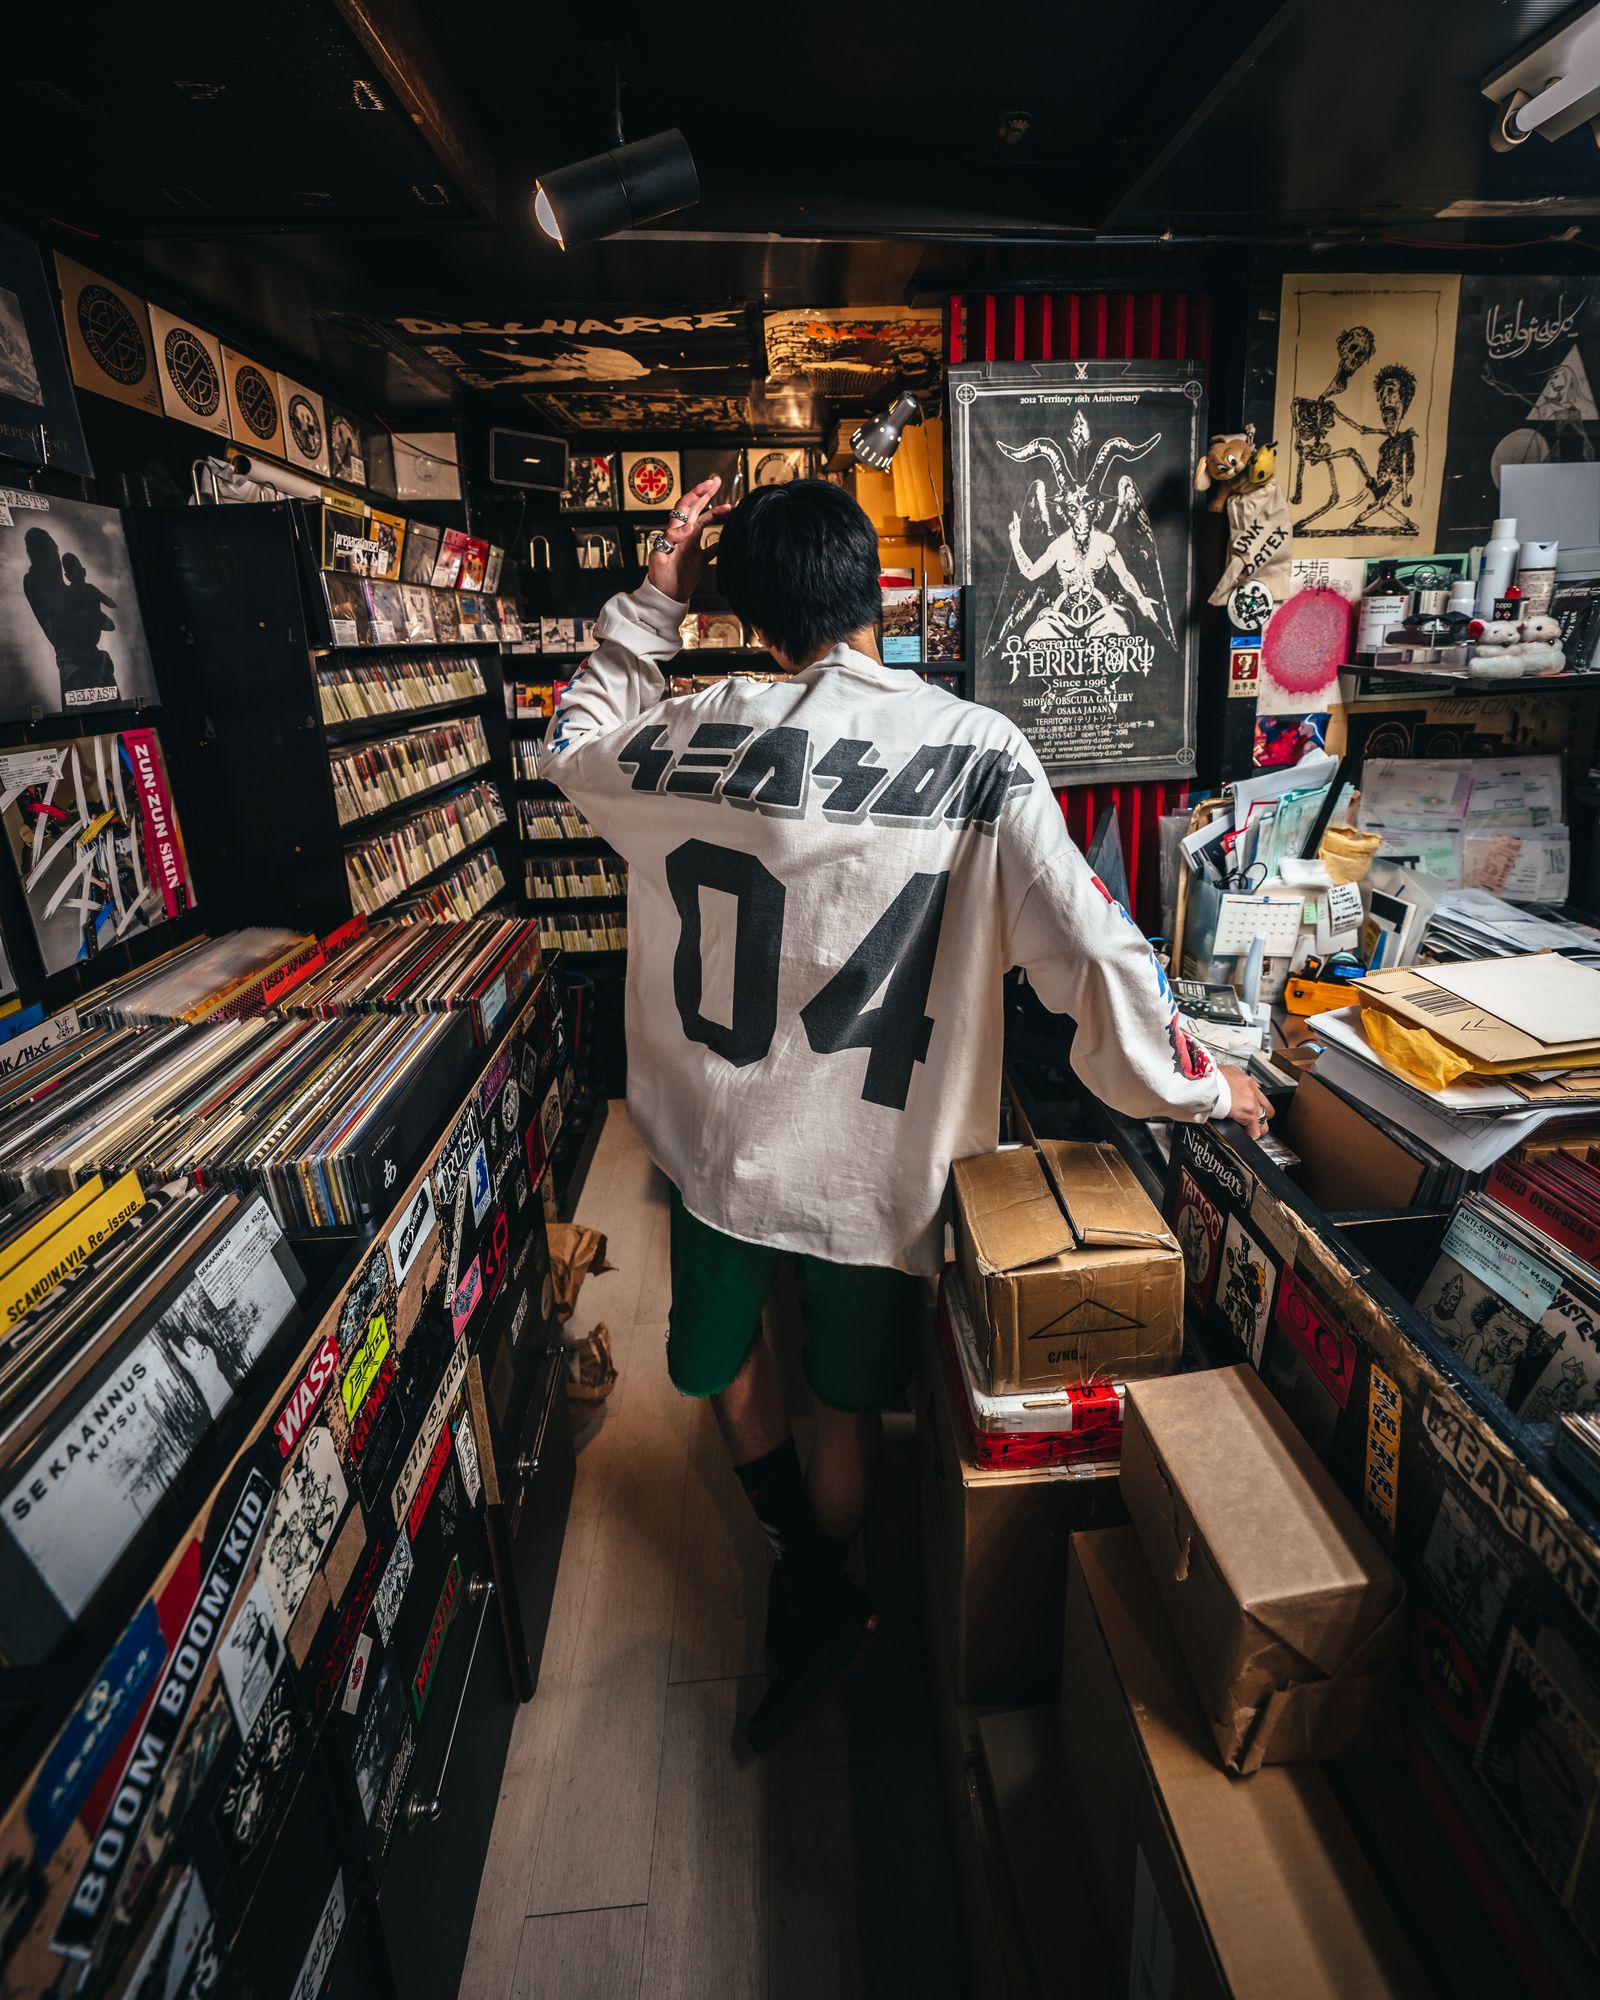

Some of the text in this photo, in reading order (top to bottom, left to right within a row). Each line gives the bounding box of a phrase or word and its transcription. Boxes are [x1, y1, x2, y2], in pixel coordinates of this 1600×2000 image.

[395, 310, 747, 335] DISCHARGE
[1020, 393, 1141, 406] 2012 Territory 16th Anniversary
[66, 687, 118, 704] BELFAST
[1022, 697, 1046, 707] SHOP
[1055, 696, 1094, 706] OBSCURA
[1096, 693, 1134, 703] GALLERY
[1052, 677, 1107, 688] Since 1996
[1035, 717, 1073, 726] TERRITORY
[1056, 706, 1083, 715] OSAKA
[159, 843, 180, 890] SKIN
[263, 970, 287, 994] USED
[283, 944, 321, 979] JAPANESE
[666, 838, 951, 1112] 04
[1181, 1125, 1249, 1208] Nightmare
[1181, 1169, 1222, 1241] TATTOO
[1495, 1171, 1597, 1244] USED OVERSEAS
[1459, 1210, 1510, 1251] ANTI-SYSTEM
[6, 1201, 142, 1322] SCANDINAVIA Re-issue.
[198, 1238, 232, 1279] SEKAANNUS
[277, 1340, 336, 1447] WASS
[12, 1362, 148, 1521] SEKAANNUS
[87, 1402, 138, 1464] KUTSU
[72, 1732, 166, 1919] BOOM
[160, 1573, 232, 1717] BOOM
[222, 1491, 263, 1566] KID
